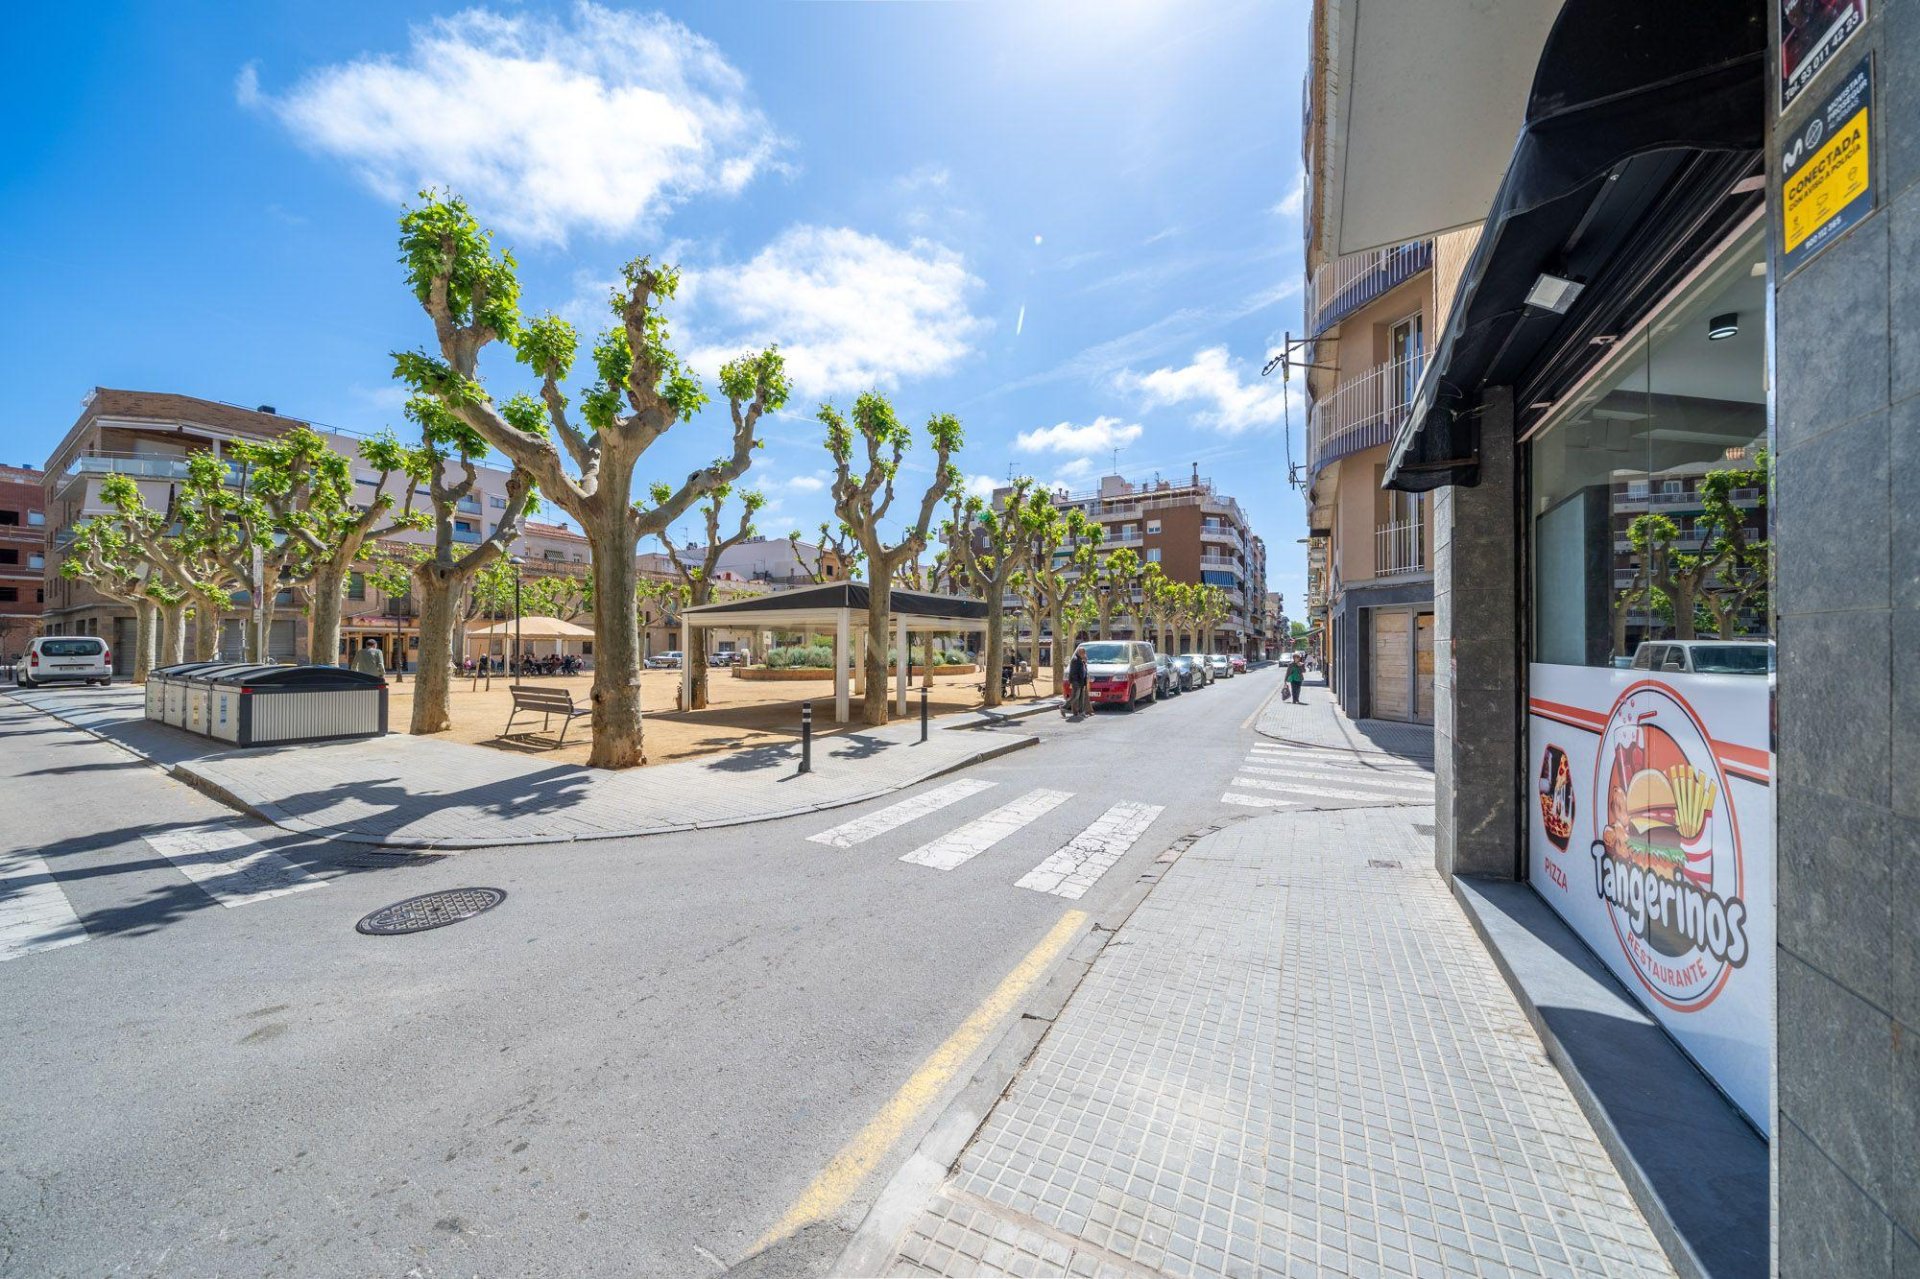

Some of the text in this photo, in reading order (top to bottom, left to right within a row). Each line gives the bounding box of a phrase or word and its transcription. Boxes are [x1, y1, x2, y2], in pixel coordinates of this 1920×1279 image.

[1784, 10, 1859, 101] Tel. 93 011 42 23
[1827, 72, 1864, 113] MOVISTAR
[1827, 79, 1868, 122] PROSEGUR
[1788, 195, 1804, 212] CON
[1803, 176, 1825, 199] AVISO
[1831, 143, 1861, 174] POLICÍA
[1789, 128, 1861, 200] CONECTADA
[1544, 856, 1568, 893] PIZZA
[1592, 841, 1747, 966] Tangerinos
[1627, 930, 1707, 988] RESTAURANTE
